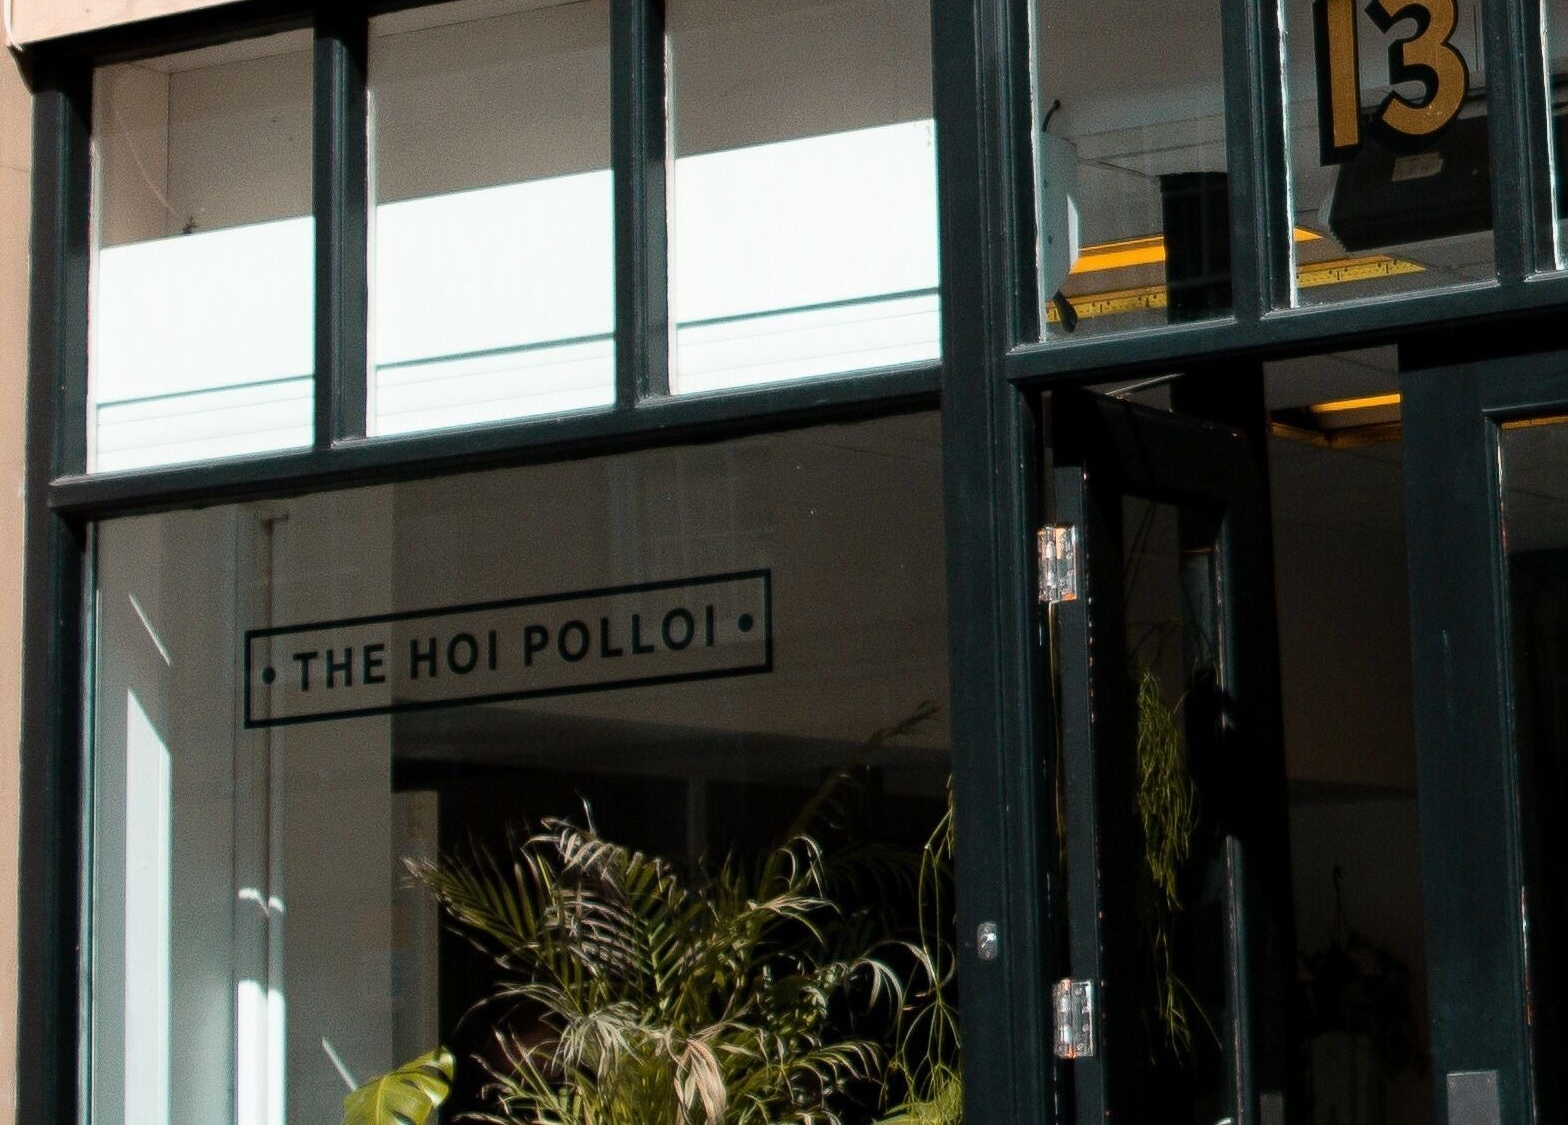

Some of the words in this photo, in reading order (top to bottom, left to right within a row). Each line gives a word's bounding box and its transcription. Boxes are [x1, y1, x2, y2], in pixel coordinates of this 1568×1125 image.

[293, 643, 387, 692] THE
[409, 630, 498, 680] HOI
[522, 604, 715, 667] POLLOI
